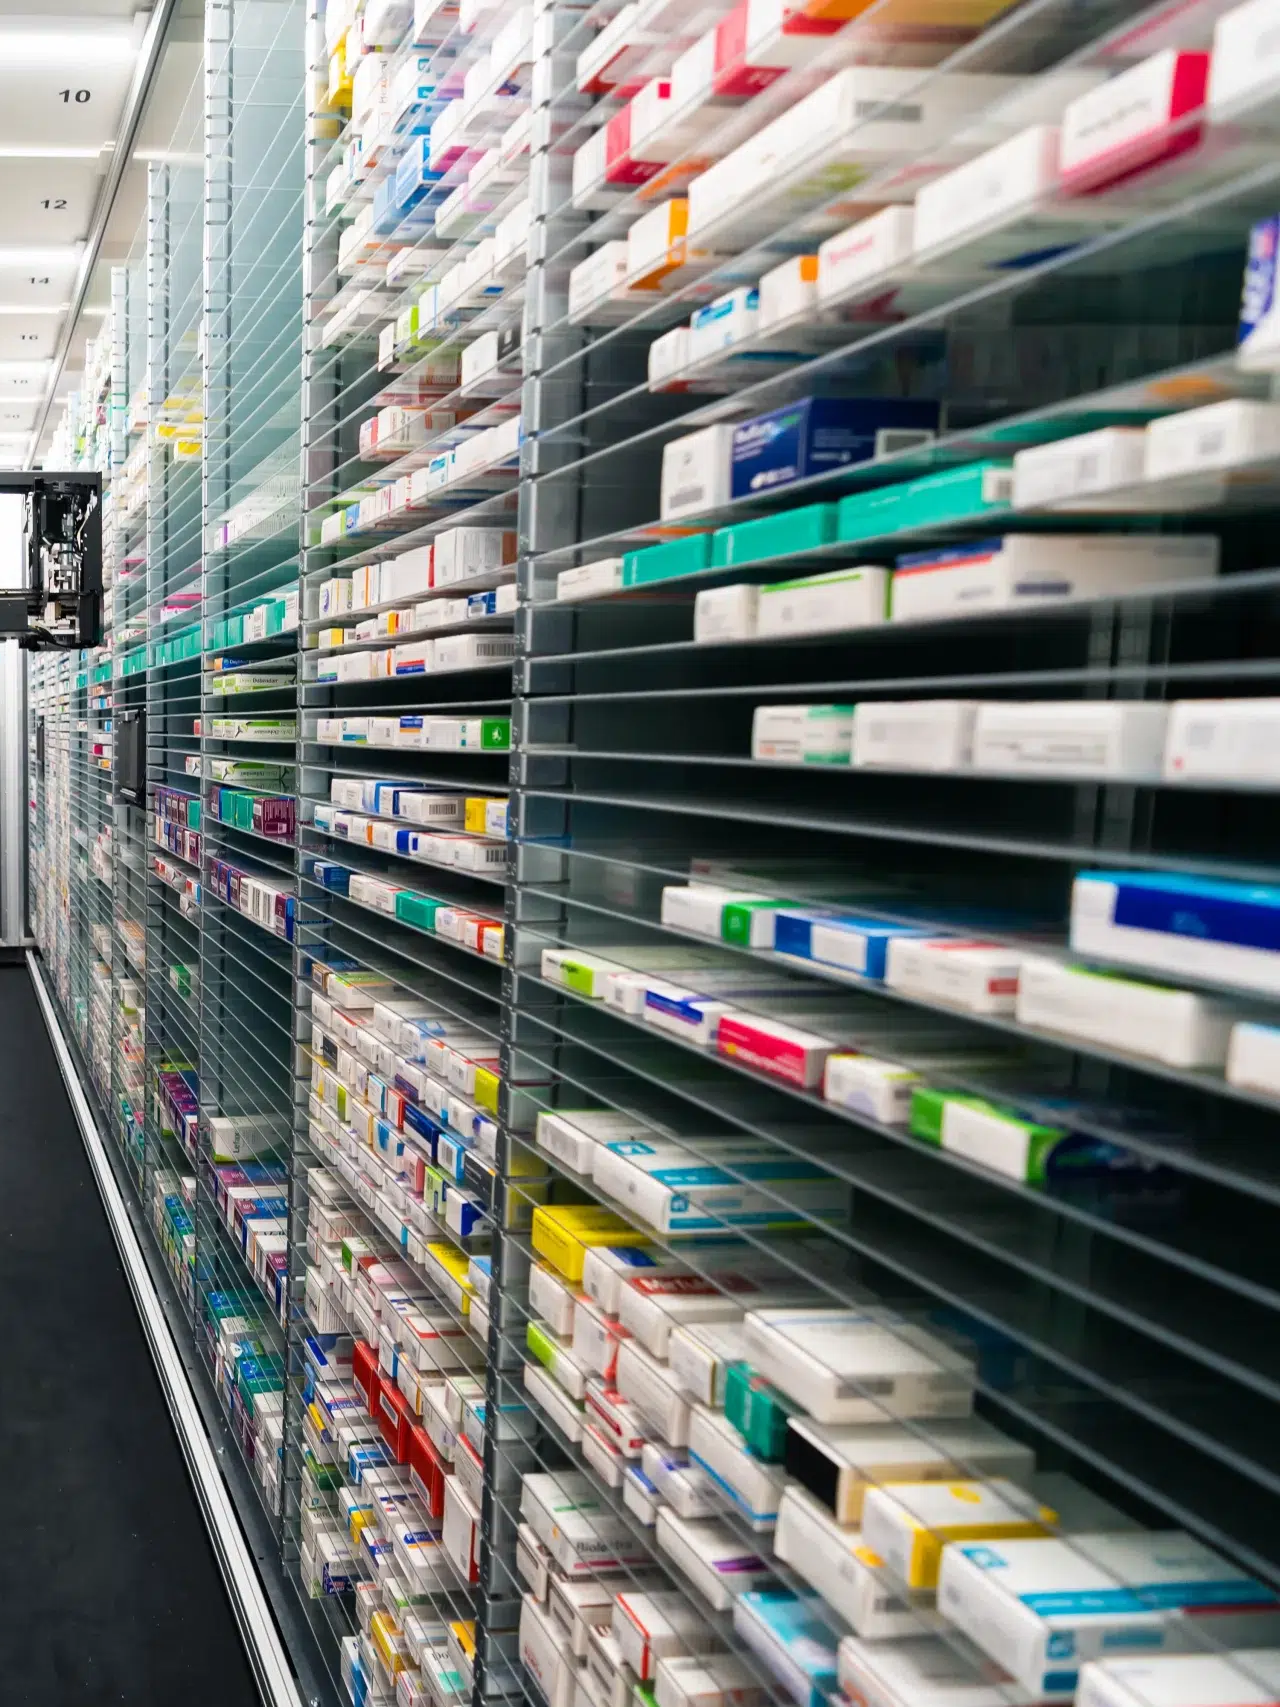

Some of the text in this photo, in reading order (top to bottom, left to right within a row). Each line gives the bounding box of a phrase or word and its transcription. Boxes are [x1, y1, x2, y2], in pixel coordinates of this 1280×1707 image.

[58, 89, 91, 104] 10
[40, 199, 68, 210] 12
[28, 276, 51, 285] 14
[20, 333, 39, 341] 16
